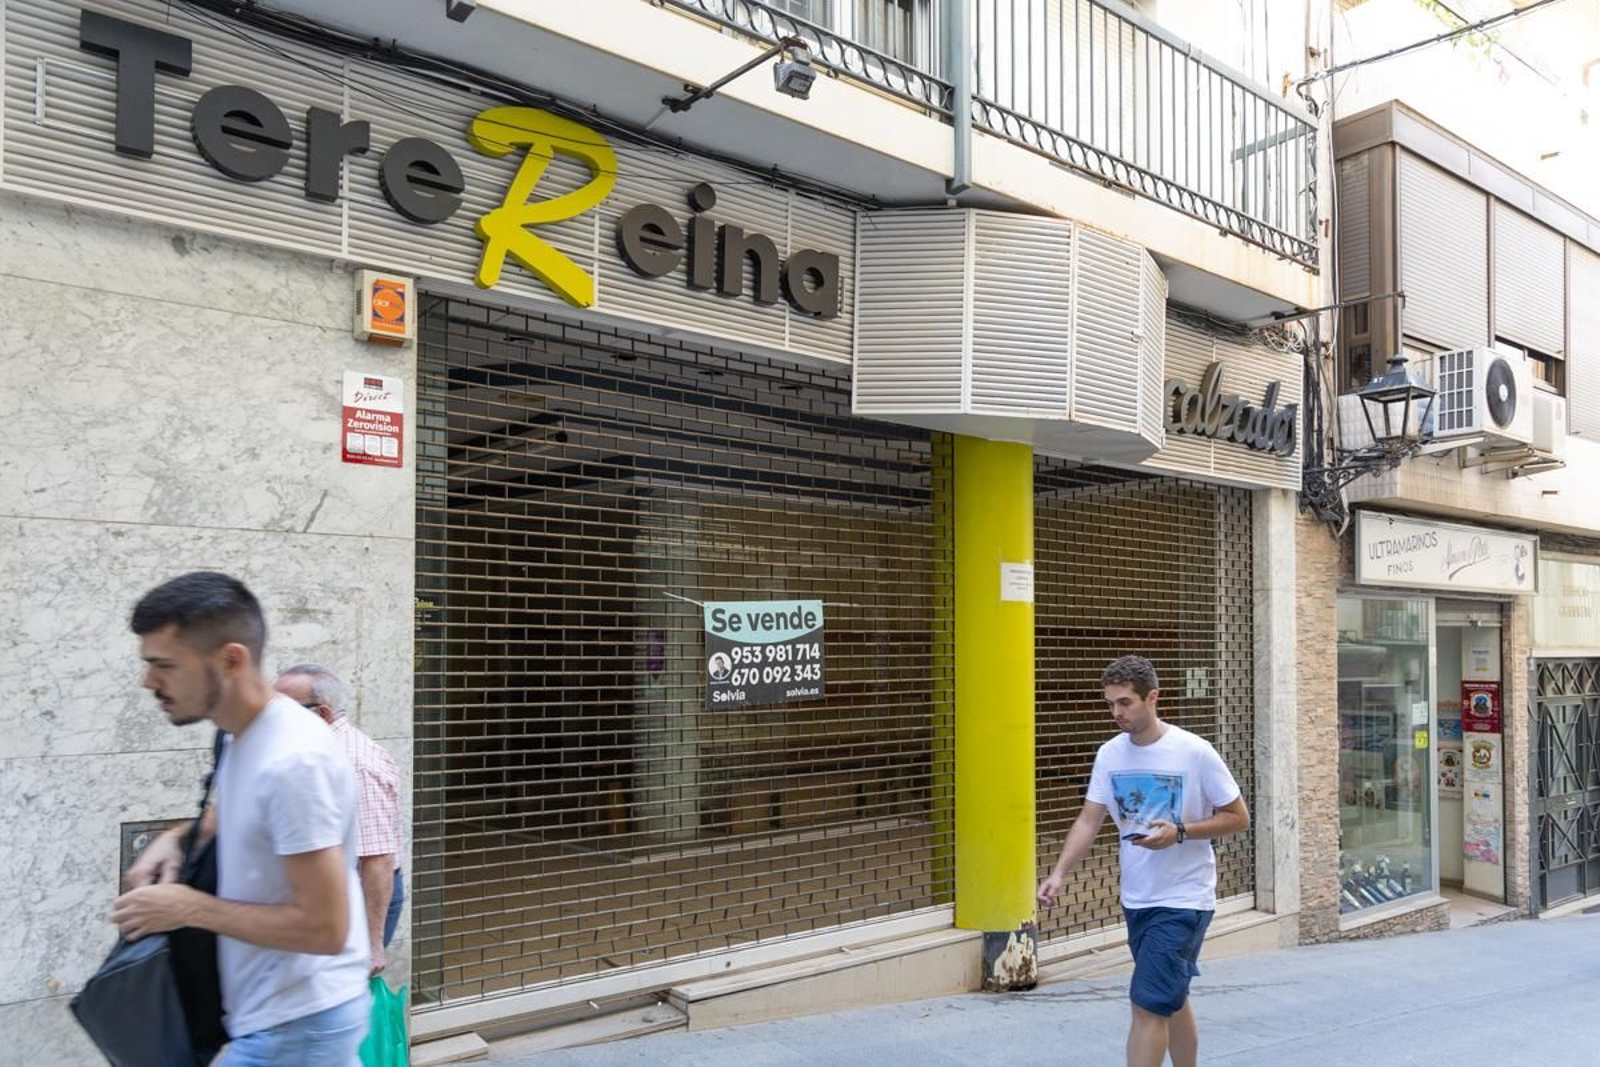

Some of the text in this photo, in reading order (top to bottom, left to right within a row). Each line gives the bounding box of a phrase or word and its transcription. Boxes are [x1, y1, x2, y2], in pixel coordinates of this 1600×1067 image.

[347, 418, 399, 433] Zerovision
[355, 410, 391, 423] Alarma
[1368, 531, 1439, 561] ULTRAMARINOS
[1387, 560, 1415, 577] FINOS
[711, 605, 817, 633] Se vende
[731, 643, 821, 664] 953 981 714
[731, 664, 821, 686] 670 092 343
[712, 687, 819, 703] Solvia solvia.es
